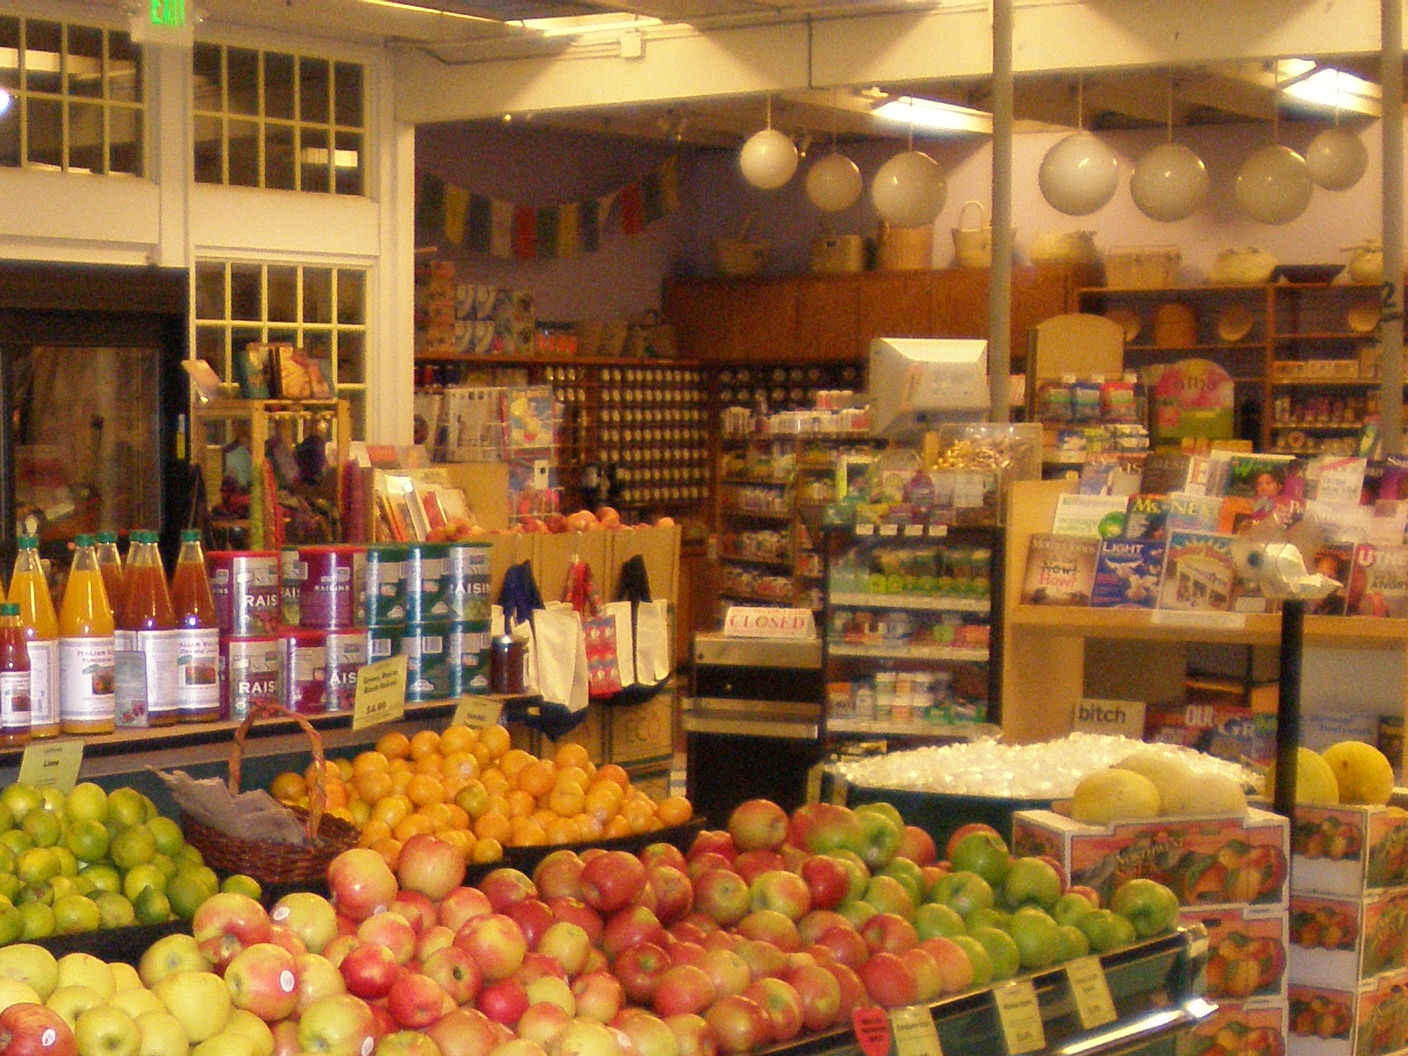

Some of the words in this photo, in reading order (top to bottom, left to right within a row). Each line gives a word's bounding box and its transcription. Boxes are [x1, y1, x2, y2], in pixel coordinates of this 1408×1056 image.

[1102, 542, 1144, 554] LIGHT
[728, 615, 805, 629] CLOSED
[1078, 703, 1127, 724] bitch
